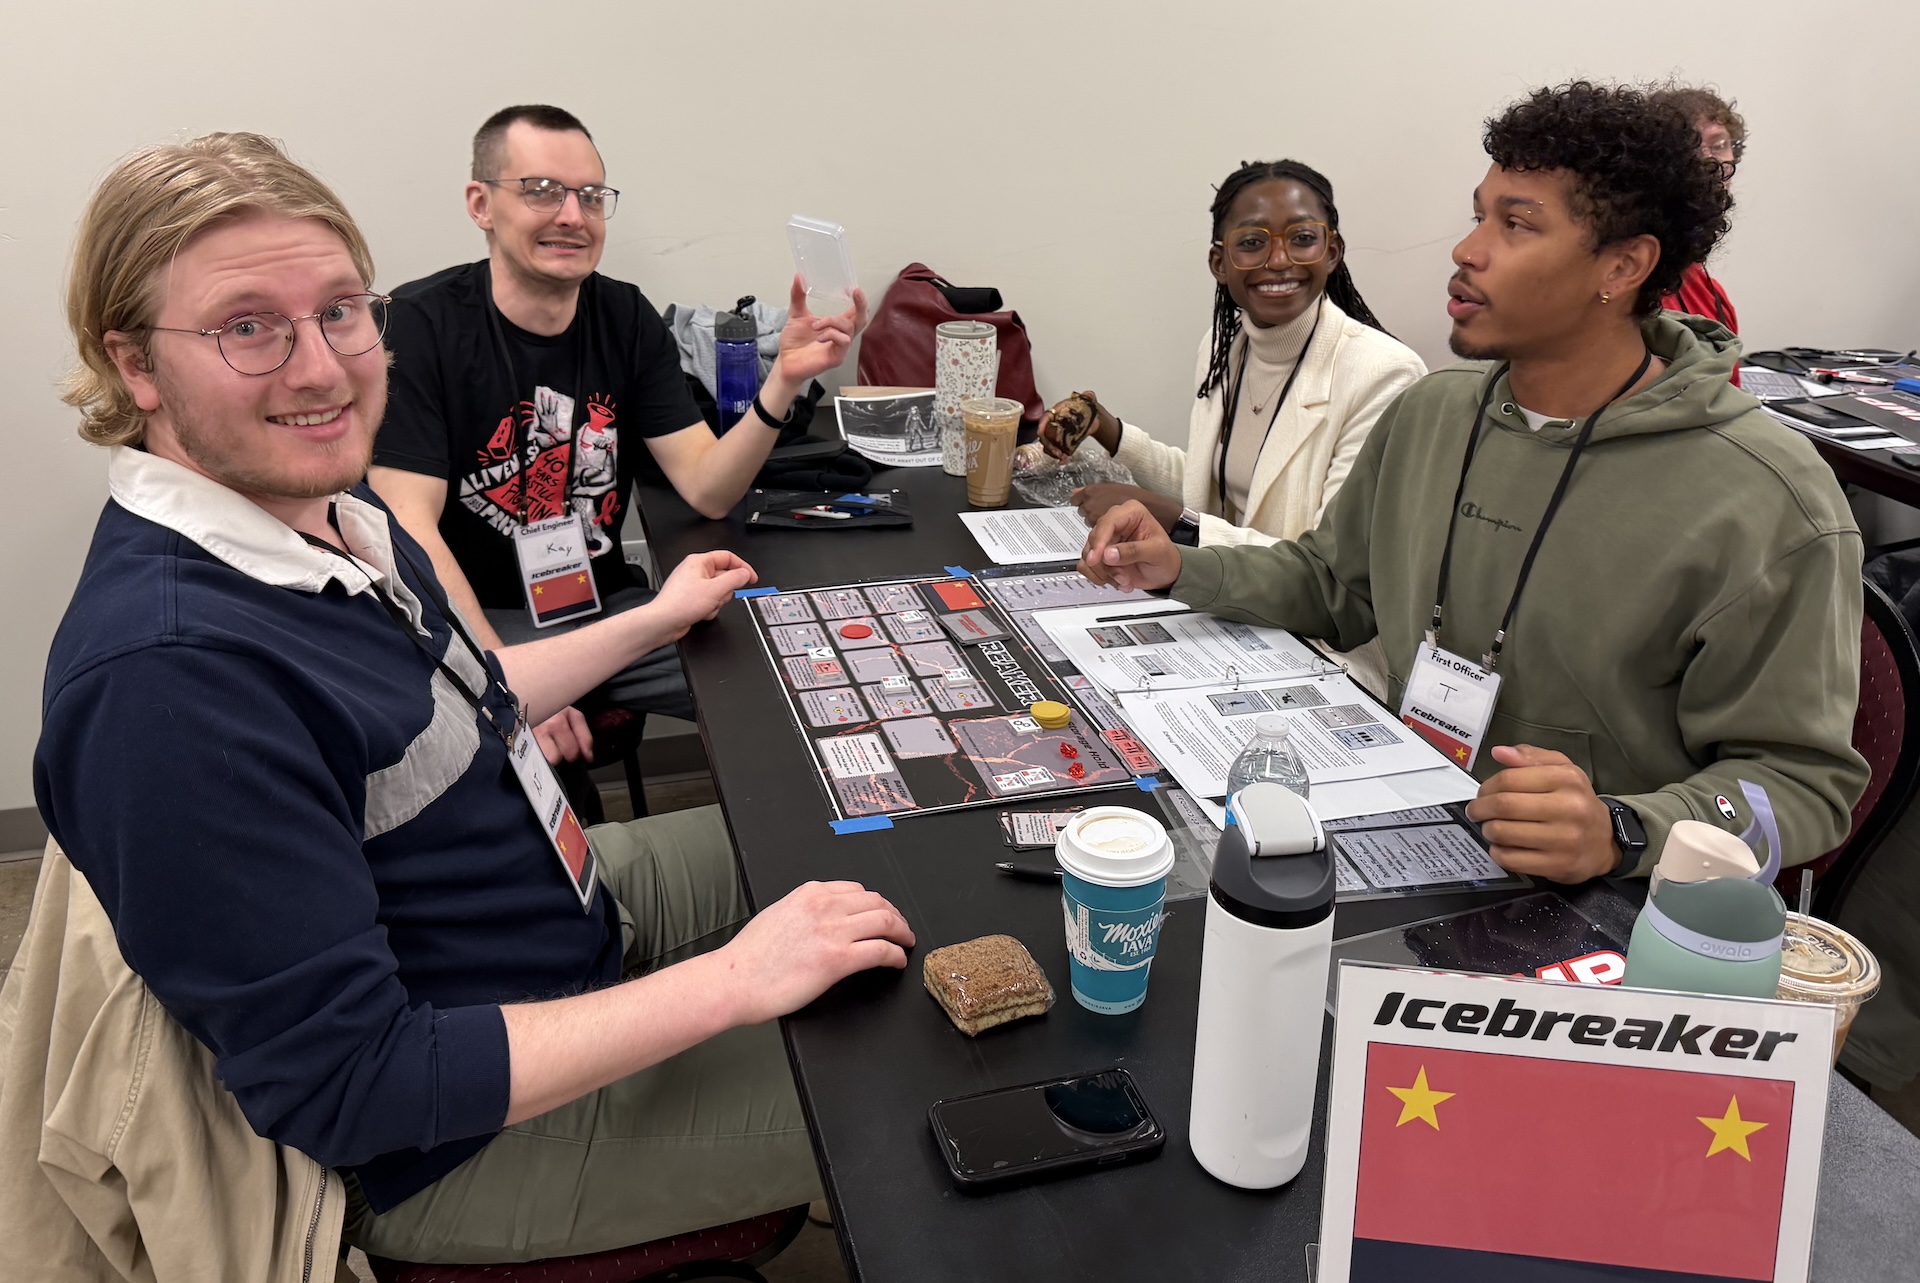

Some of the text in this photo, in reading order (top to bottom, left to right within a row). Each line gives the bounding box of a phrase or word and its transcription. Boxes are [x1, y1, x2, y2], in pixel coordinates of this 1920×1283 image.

[543, 452, 565, 474] 40
[499, 484, 558, 519] FIGTING
[521, 519, 574, 536] Chief Engineer
[1461, 502, 1523, 532] Champion
[547, 543, 573, 557] Kay
[531, 562, 583, 580] Icebreaker
[1431, 651, 1484, 682] First Officer
[1439, 682, 1458, 703] T
[1410, 706, 1472, 739] Icebreaker
[1087, 750, 1110, 769] Hold
[1098, 911, 1160, 944] Moxie
[1120, 936, 1153, 956] JAVA
[1700, 941, 1752, 959] owala
[1373, 991, 1798, 1062] Icebreaker
